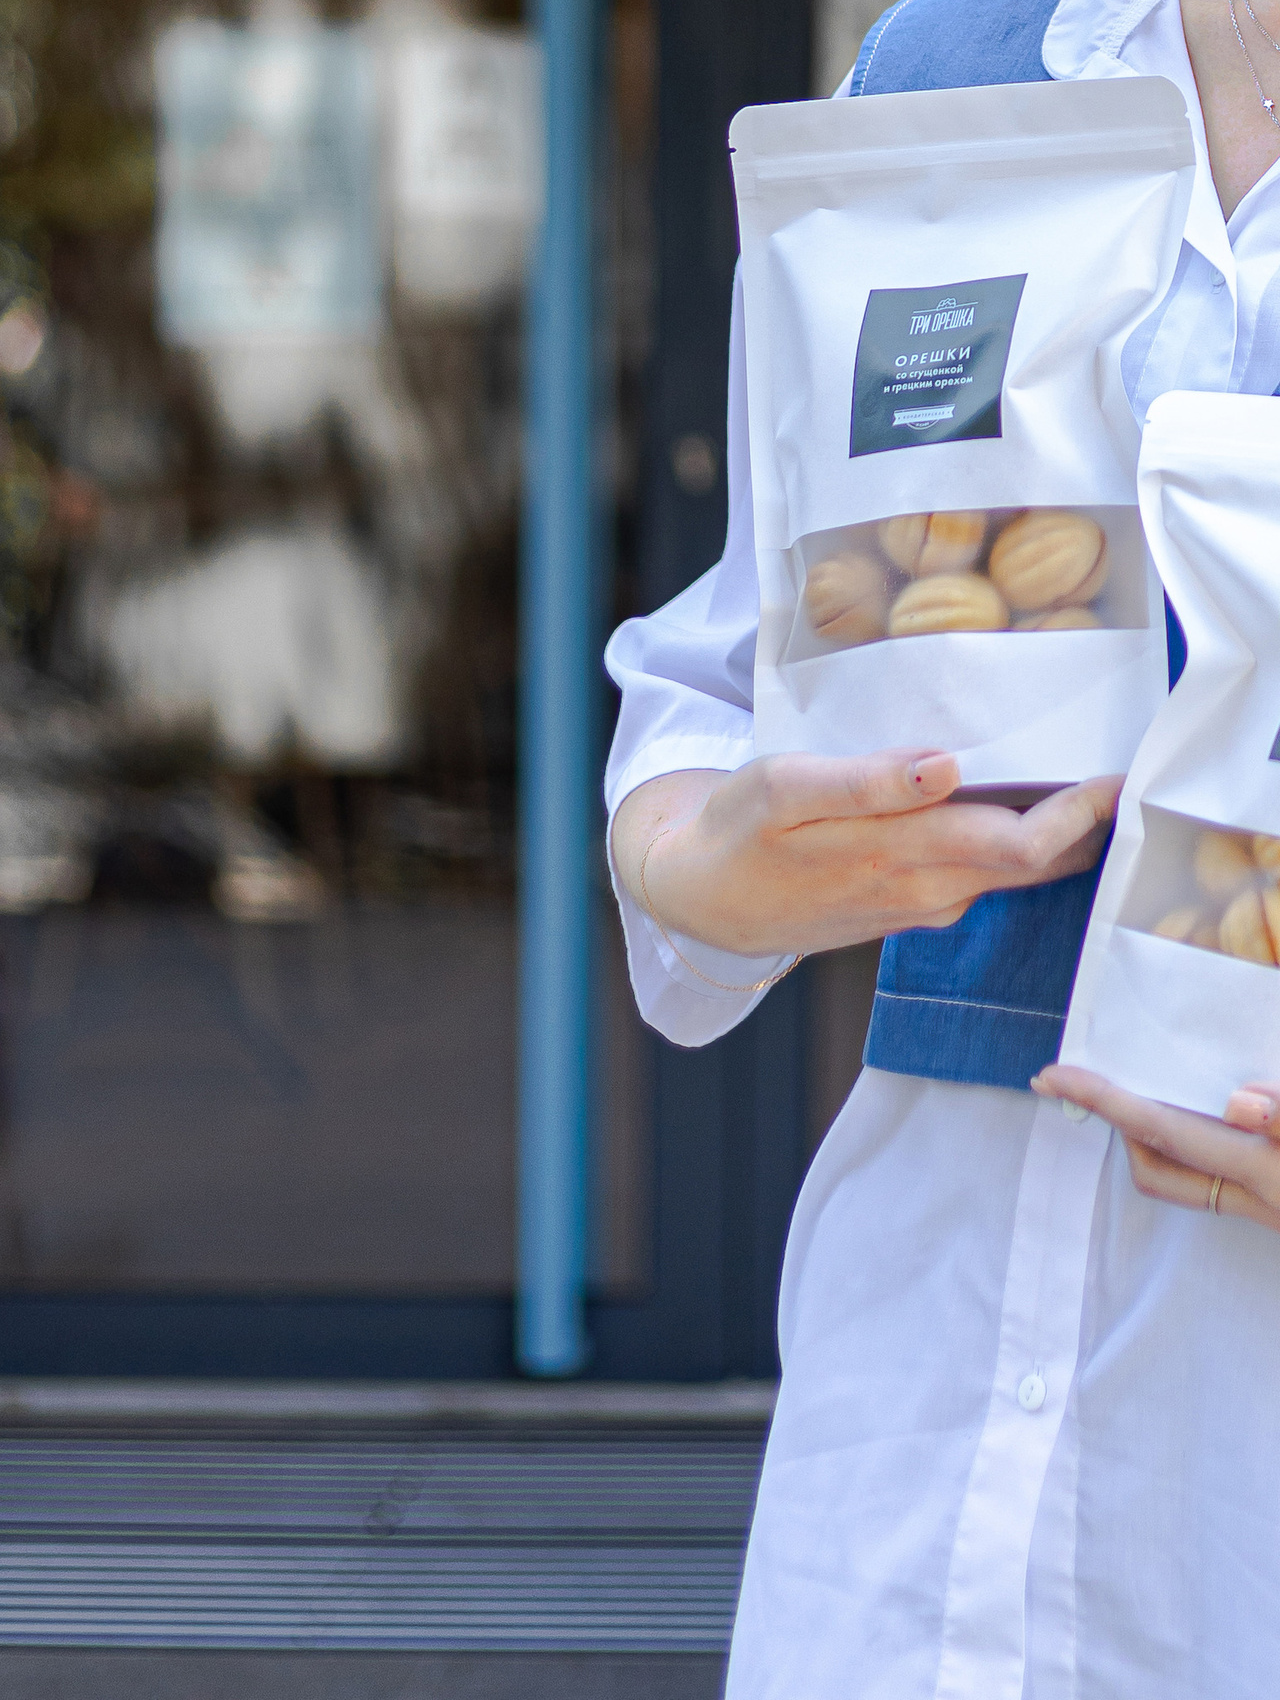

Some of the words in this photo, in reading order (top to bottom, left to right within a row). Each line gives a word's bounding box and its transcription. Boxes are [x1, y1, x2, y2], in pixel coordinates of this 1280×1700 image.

[909, 314, 932, 335] ТРИ
[931, 307, 975, 332] ОРЕШКА
[895, 346, 971, 367] ОРЕШКИ
[896, 372, 907, 380] со
[909, 364, 963, 380] сгущенкой
[883, 385, 890, 393] и
[892, 380, 933, 394] грецким
[934, 376, 973, 389] орехом
